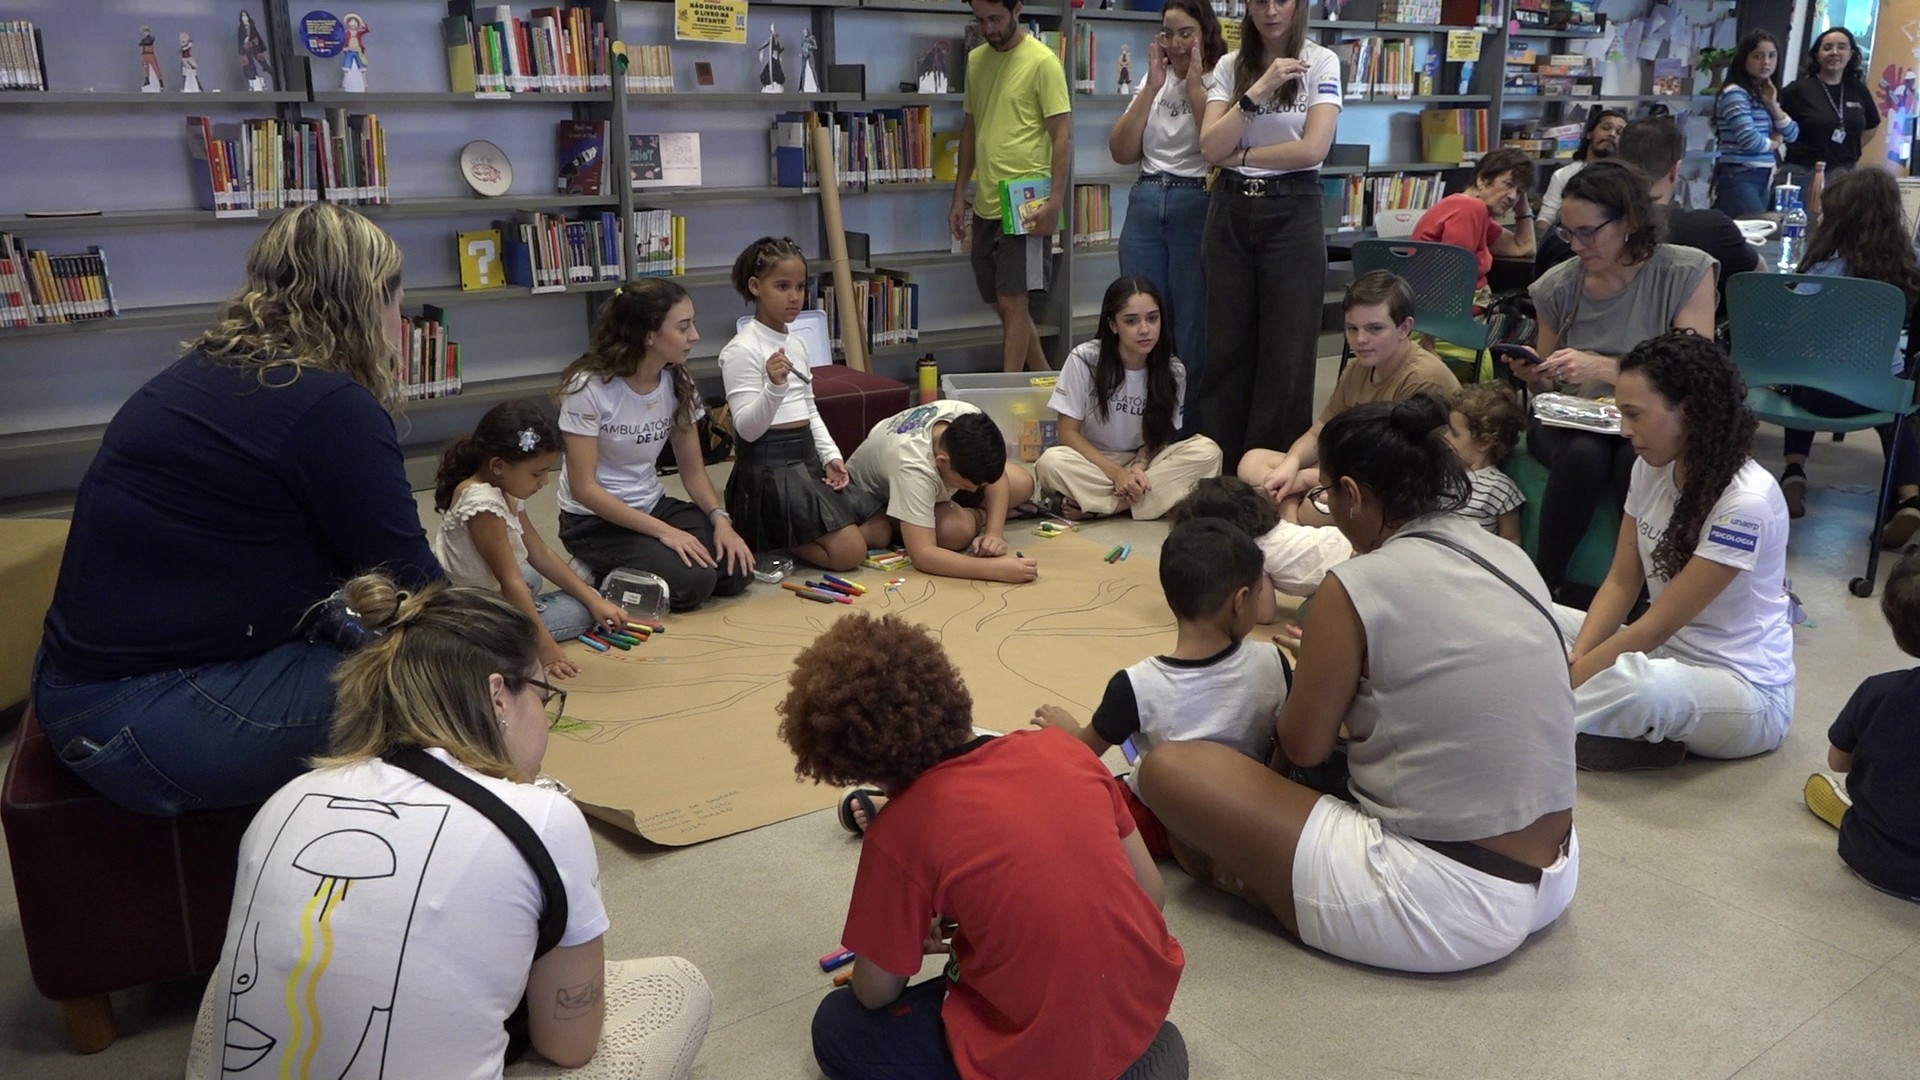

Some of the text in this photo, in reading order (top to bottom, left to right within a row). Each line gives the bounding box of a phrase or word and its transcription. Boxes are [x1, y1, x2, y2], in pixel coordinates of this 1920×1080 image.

[705, 4, 734, 12] DEVOLVA
[1515, 10, 1539, 24] WAR
[1116, 402, 1145, 417] DE LU
[599, 416, 673, 435] AMBULATÓRI
[636, 428, 672, 444] DE LUT
[1730, 517, 1760, 531] unaerp
[1711, 530, 1755, 547] PSICOLOGIA
